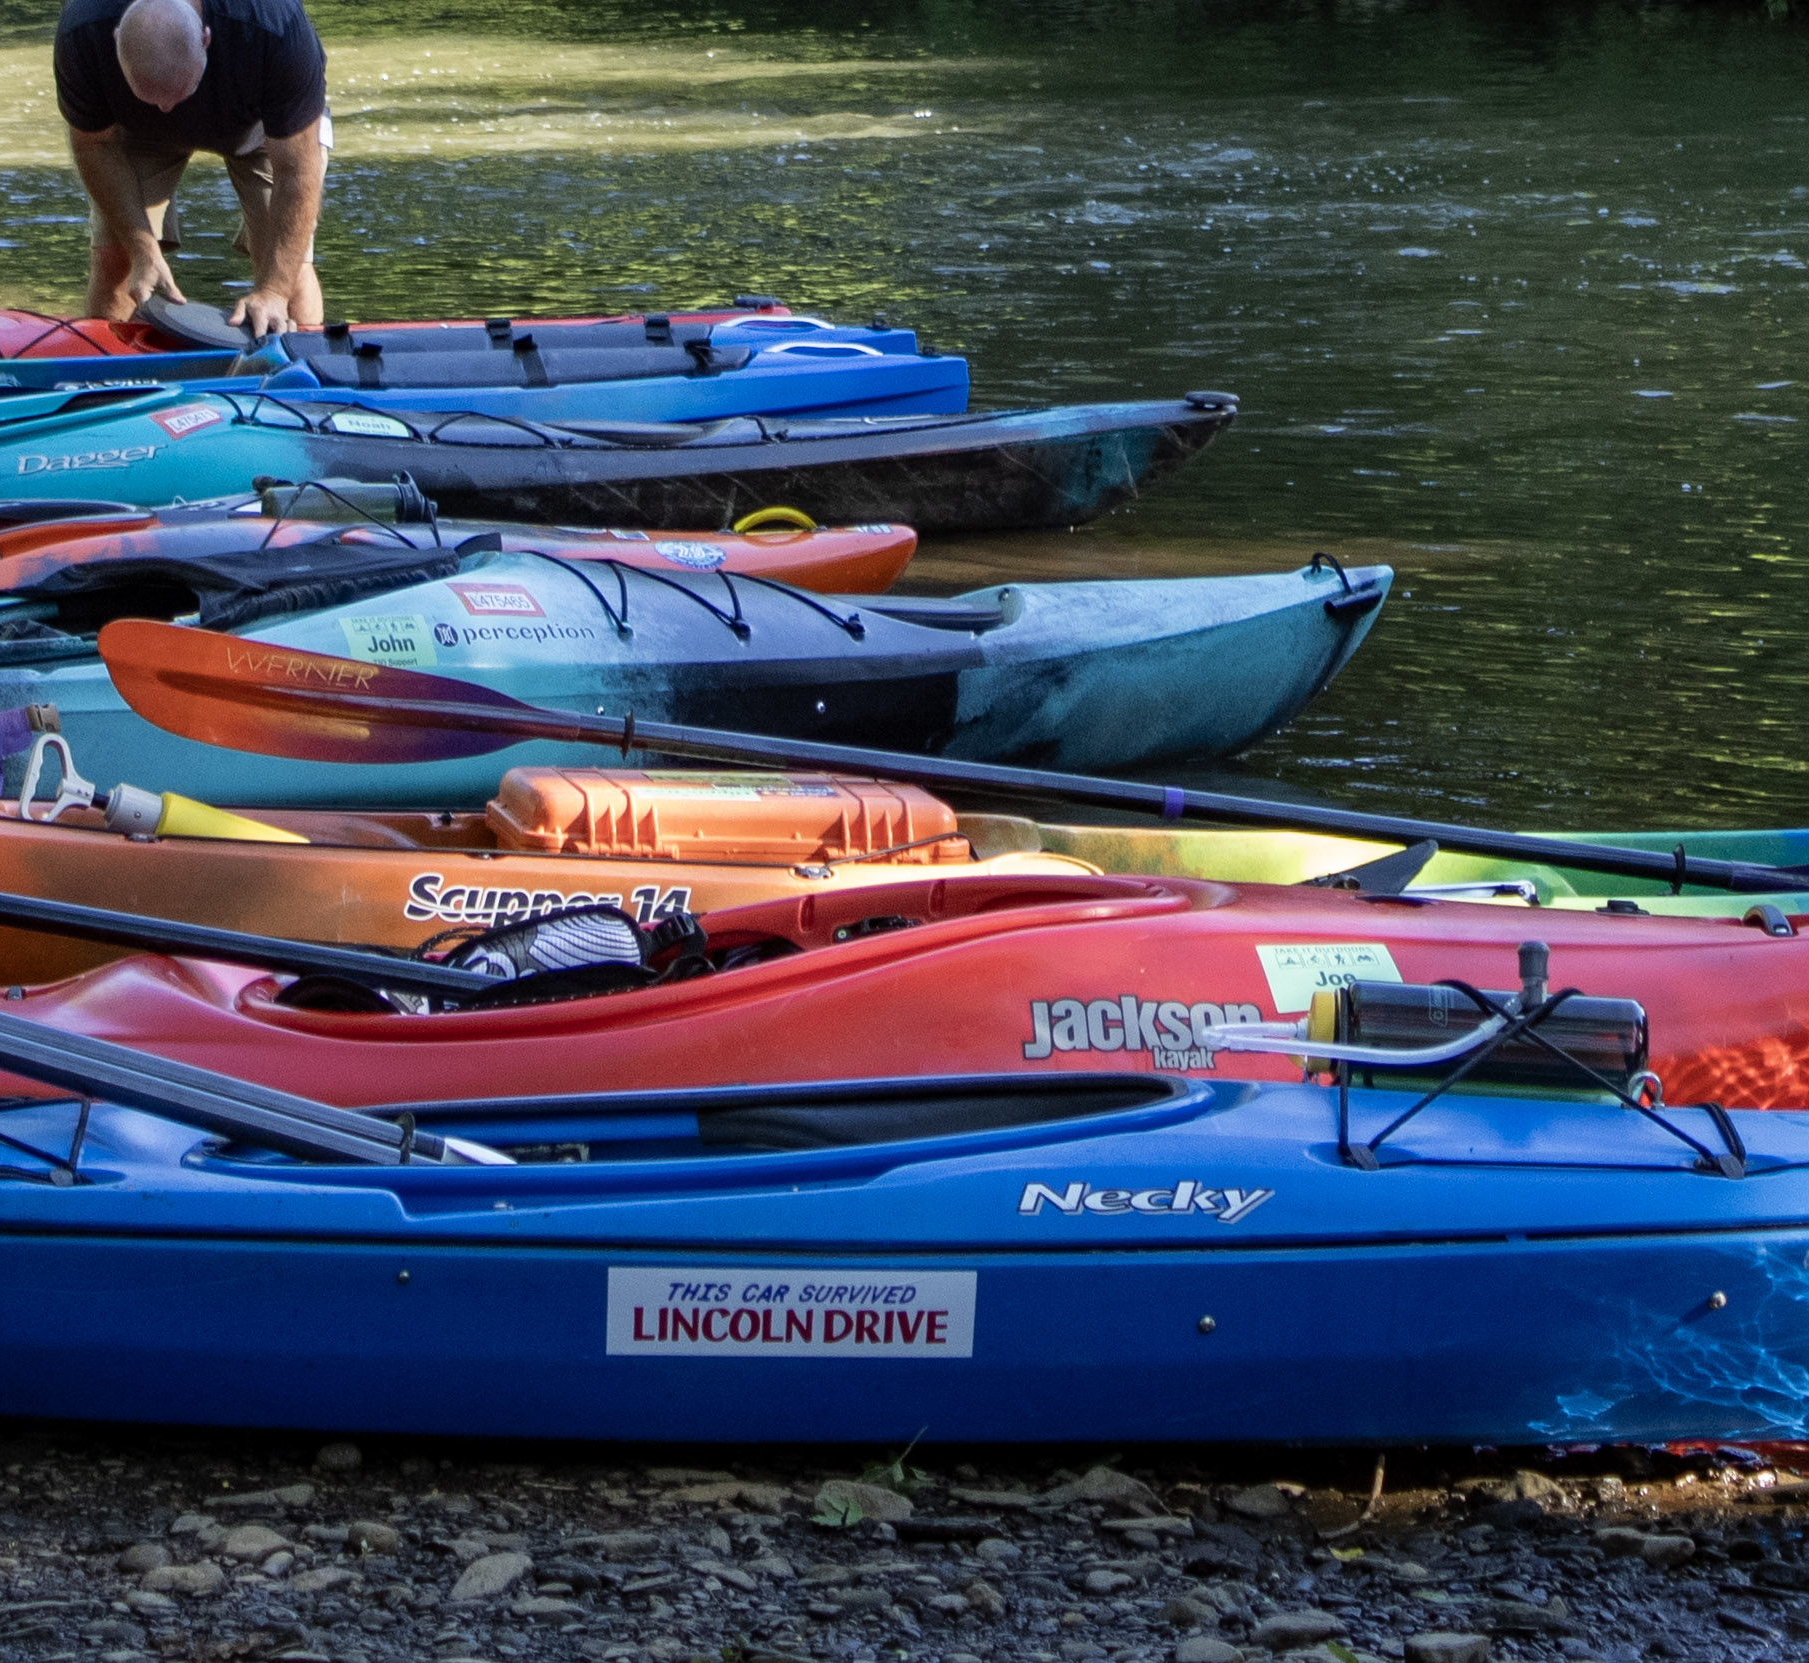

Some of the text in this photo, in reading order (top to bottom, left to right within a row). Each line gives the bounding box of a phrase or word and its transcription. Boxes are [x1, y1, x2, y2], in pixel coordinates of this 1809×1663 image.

[17, 444, 168, 476] Dagger
[469, 594, 532, 608] L475465
[368, 634, 416, 653] John
[463, 624, 595, 644] perception
[226, 646, 375, 691] WERNER
[630, 885, 692, 924] 14
[1316, 970, 1357, 987] Joe
[1023, 995, 1263, 1060] jackson
[1153, 1045, 1217, 1072] kayak
[1017, 1180, 1275, 1224] Necky
[667, 1282, 917, 1304] THIS CAR SURVIVED
[632, 1306, 949, 1344] LINCOLN DRIVE
